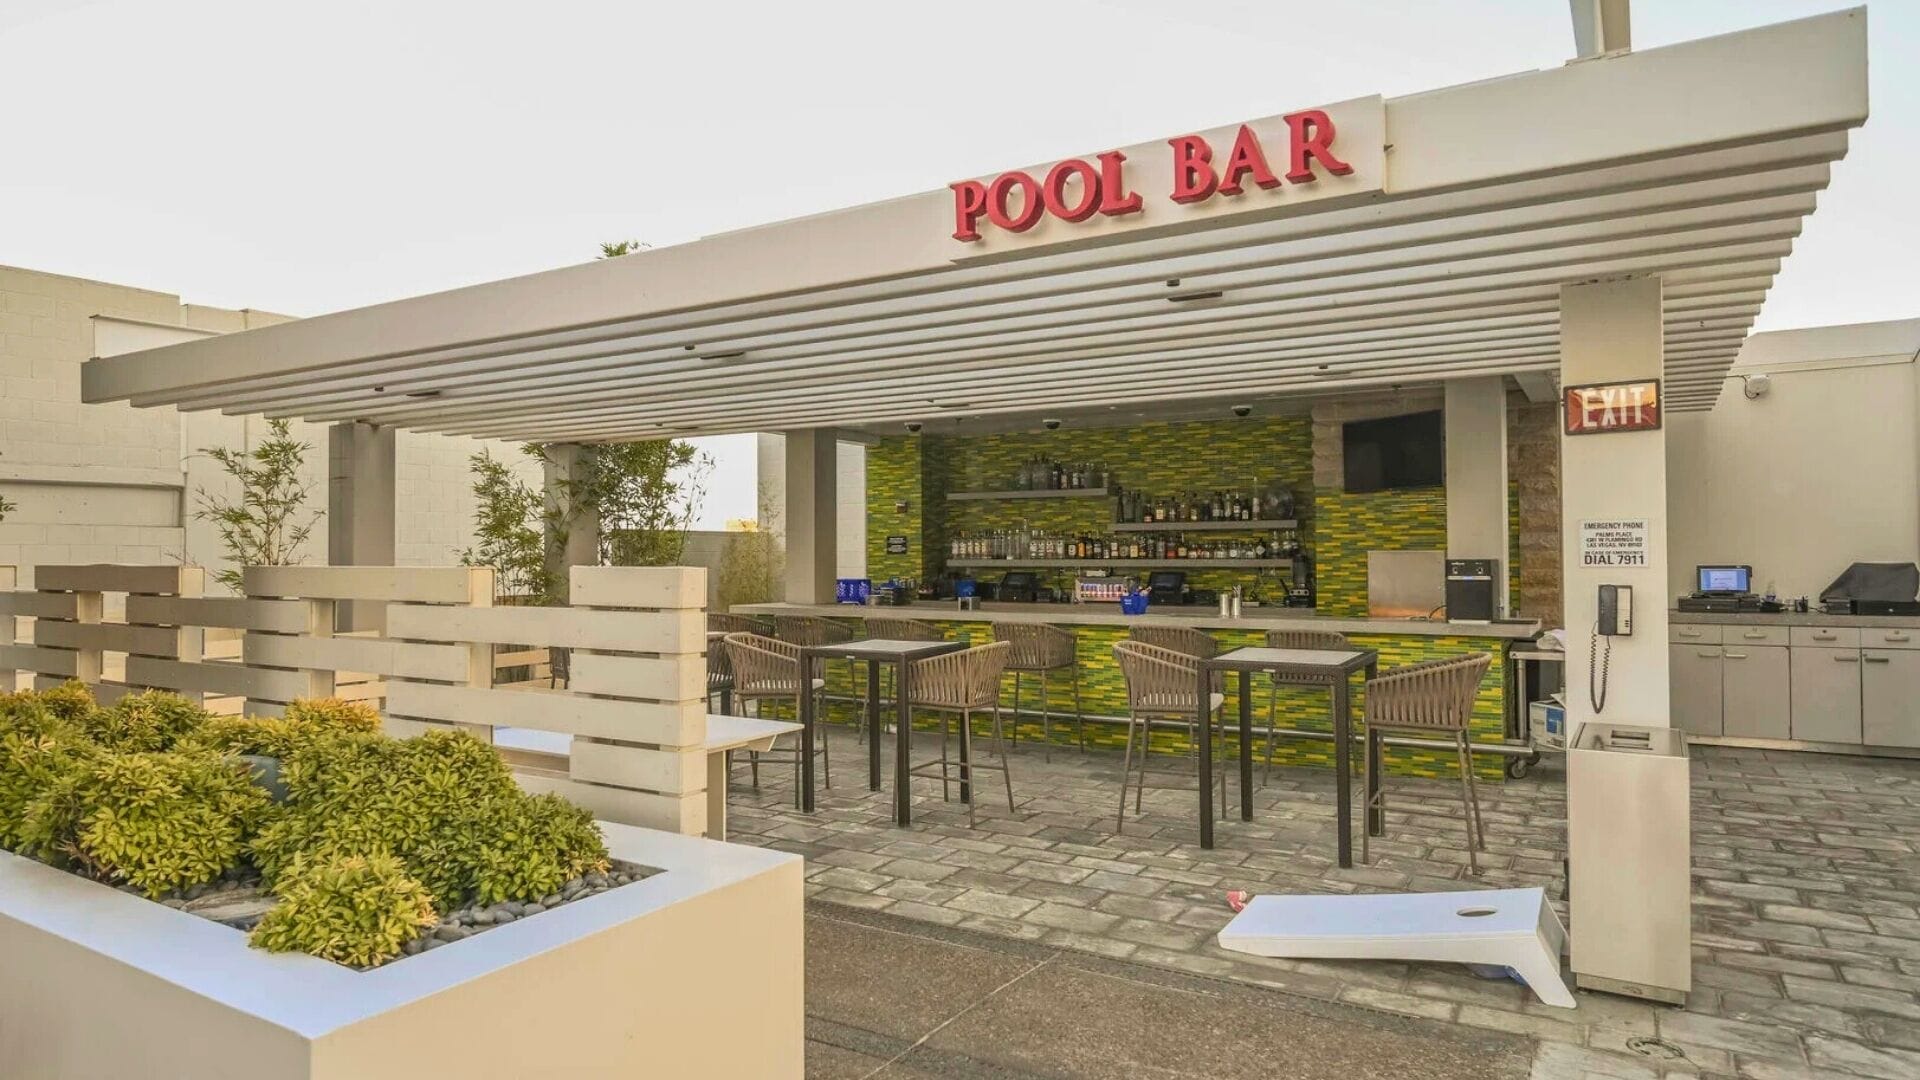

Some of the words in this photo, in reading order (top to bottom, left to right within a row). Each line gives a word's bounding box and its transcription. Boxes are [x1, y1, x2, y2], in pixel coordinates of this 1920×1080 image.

[950, 150, 1143, 242] POOL
[1168, 110, 1354, 204] BAR
[1582, 386, 1645, 428] EXIT
[1584, 555, 1614, 565] DIAL
[1617, 555, 1644, 565] 7911
